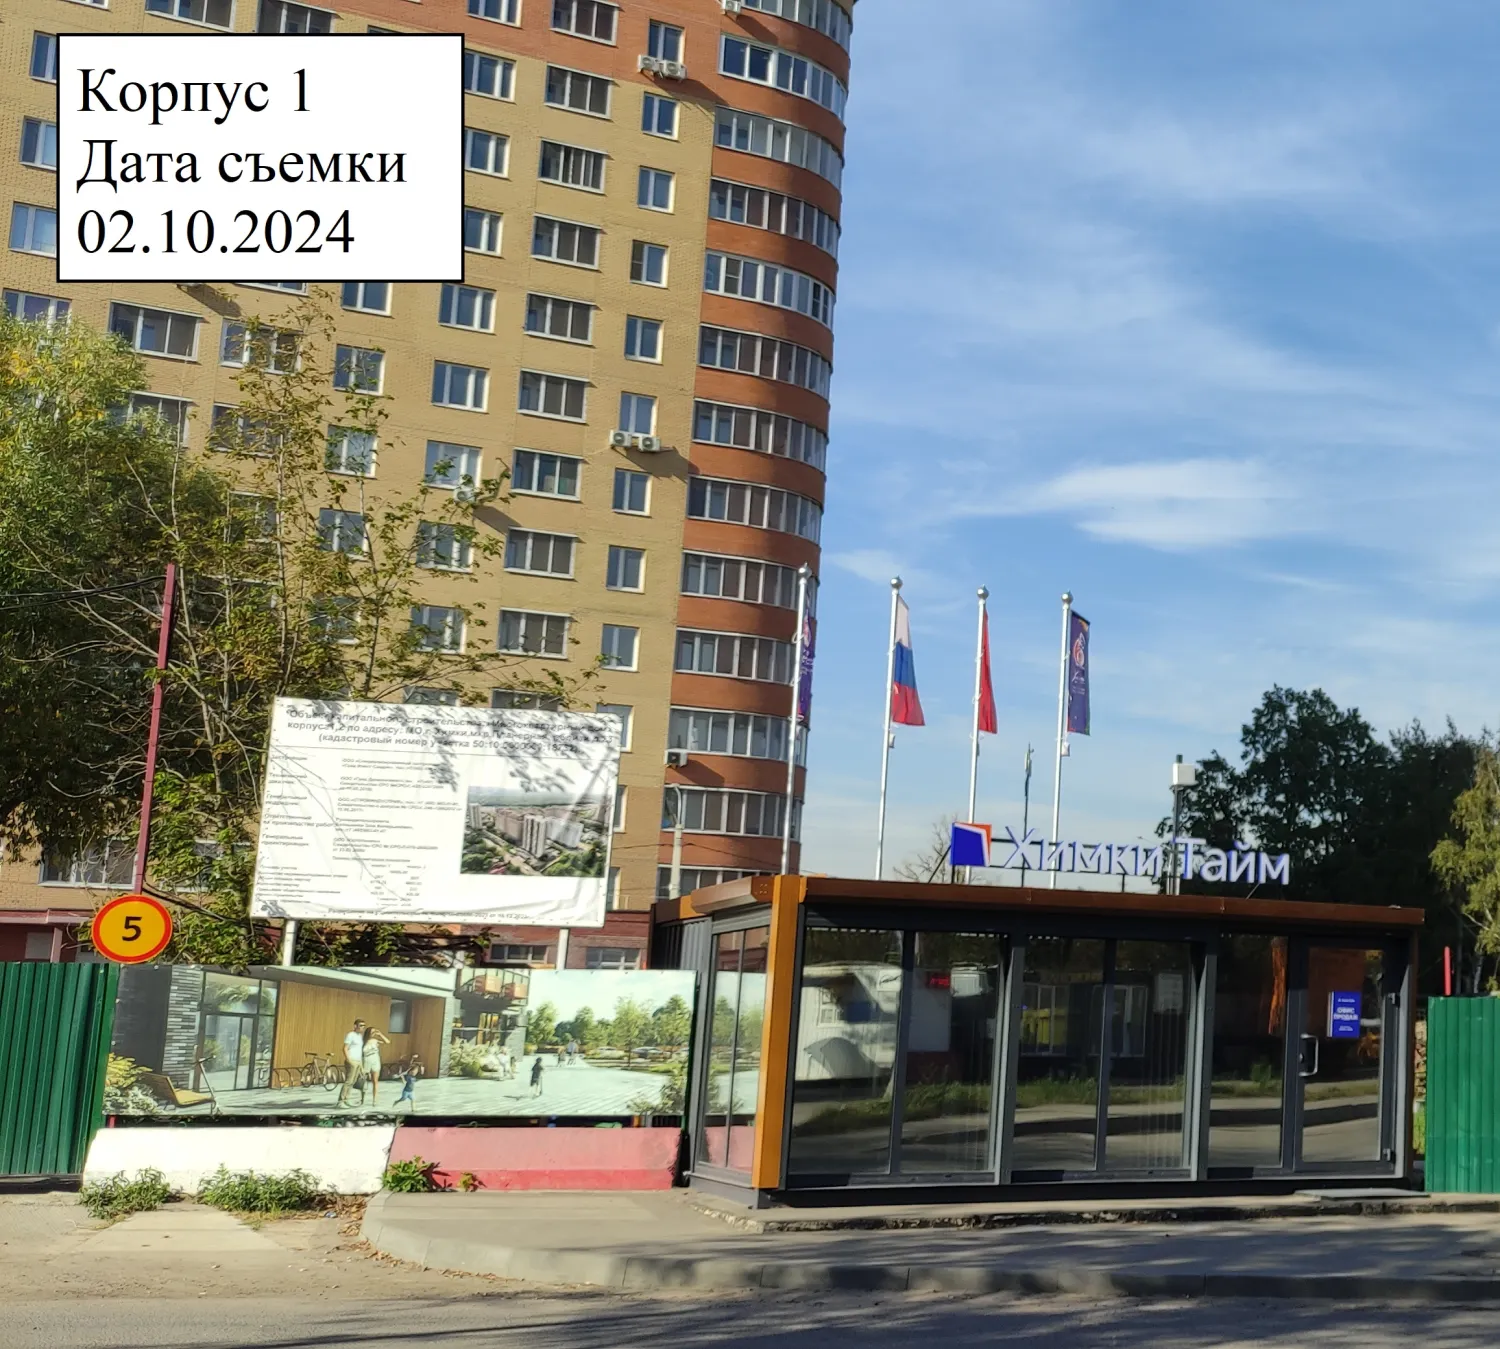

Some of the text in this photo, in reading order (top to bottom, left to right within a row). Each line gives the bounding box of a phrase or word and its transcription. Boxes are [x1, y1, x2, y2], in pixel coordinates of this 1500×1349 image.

[319, 733, 392, 744] (кадастровый
[395, 738, 428, 747] номер
[1004, 826, 1290, 885] Химки Тайм
[121, 916, 143, 942] 5
